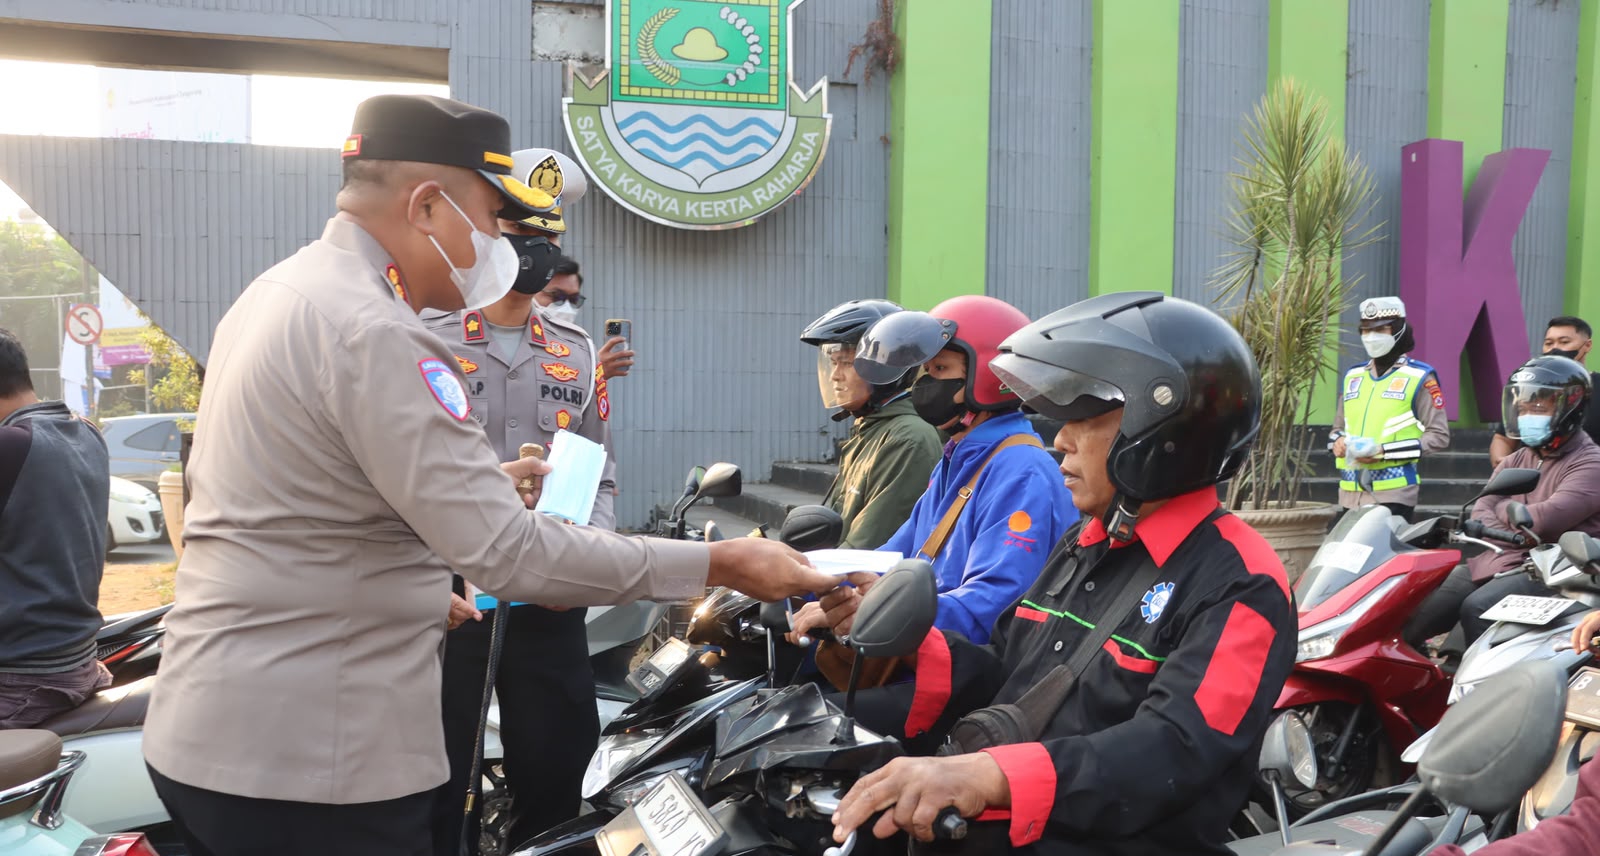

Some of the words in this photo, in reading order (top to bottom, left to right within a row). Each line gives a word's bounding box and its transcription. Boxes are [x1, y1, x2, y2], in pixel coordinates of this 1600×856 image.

[577, 116, 618, 180] SATYA
[616, 173, 680, 215] KARYA
[685, 195, 753, 218] KERTA
[752, 132, 819, 206] RAHARJA
[1402, 138, 1552, 422] K
[469, 381, 484, 395] .P
[541, 384, 582, 405] POLRI
[1574, 676, 1592, 690] B
